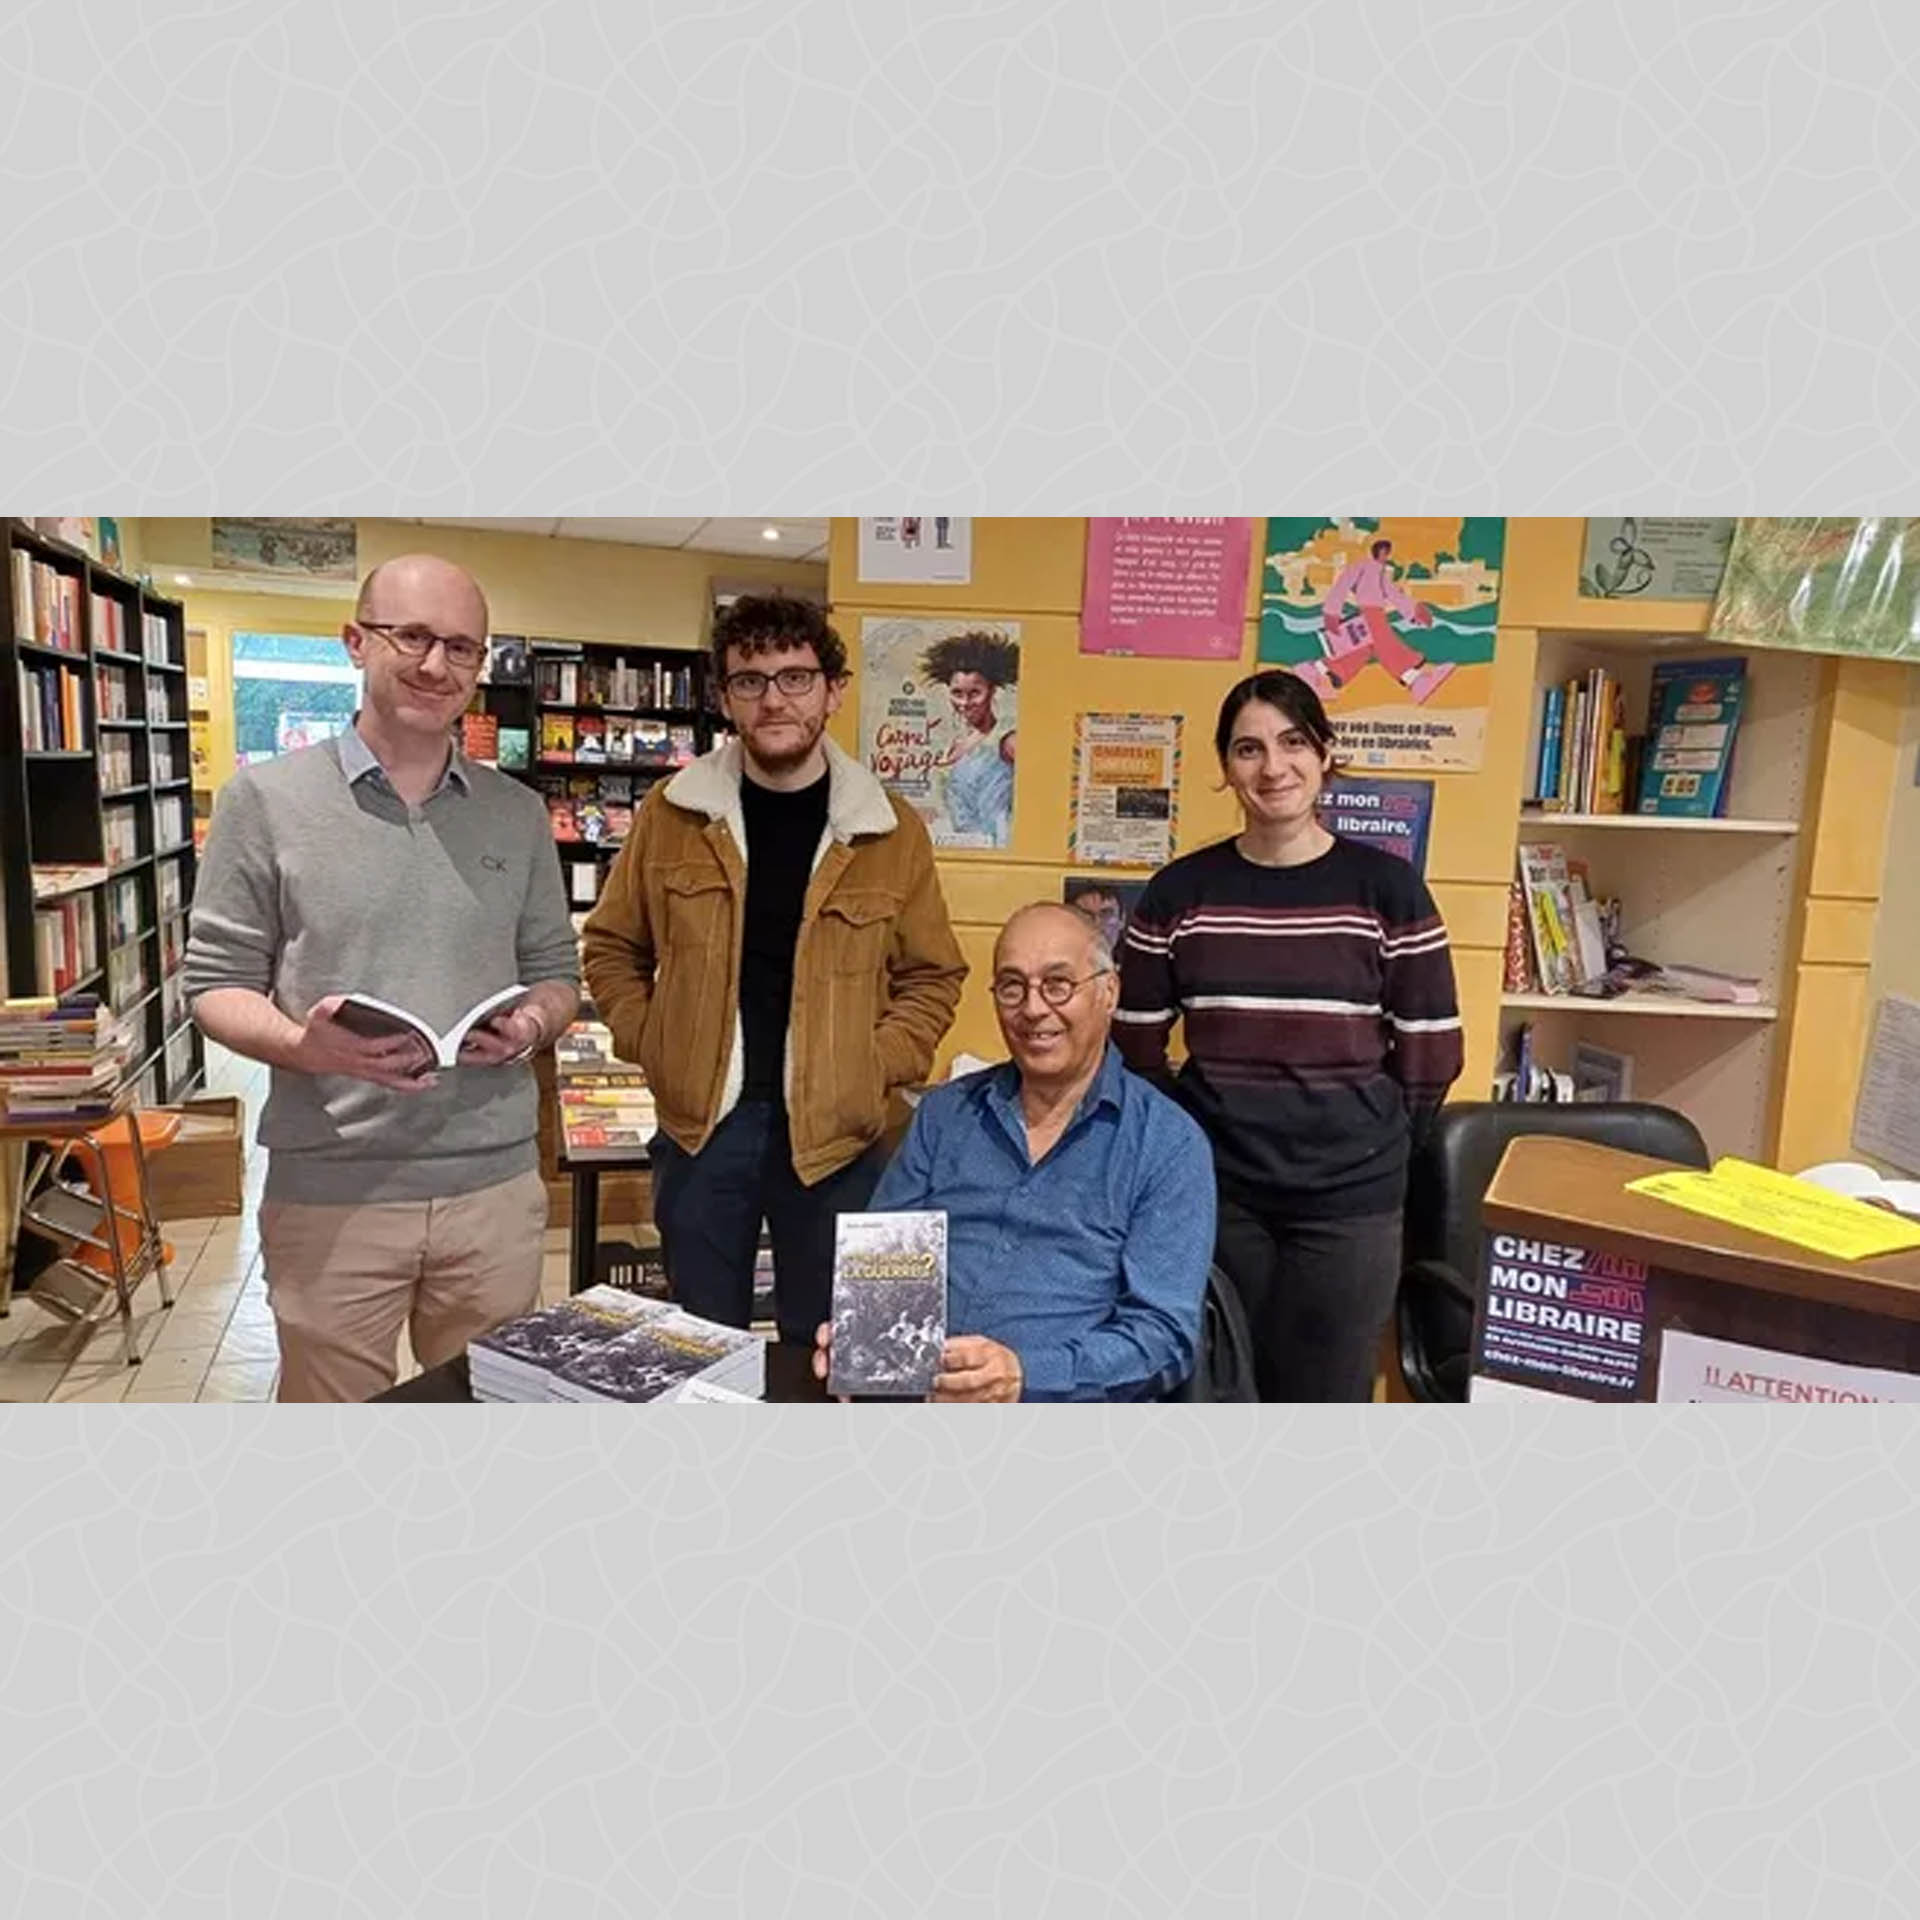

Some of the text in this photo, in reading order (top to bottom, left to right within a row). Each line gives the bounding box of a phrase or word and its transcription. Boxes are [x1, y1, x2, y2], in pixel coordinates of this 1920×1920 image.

[1407, 723, 1422, 735] en
[1337, 793, 1380, 808] mon
[1337, 812, 1411, 831] libraire,
[480, 855, 507, 872] CK
[1493, 1235, 1585, 1270] CHEZ
[1491, 1265, 1568, 1299] MON
[1487, 1295, 1643, 1345] LIBRAIRE
